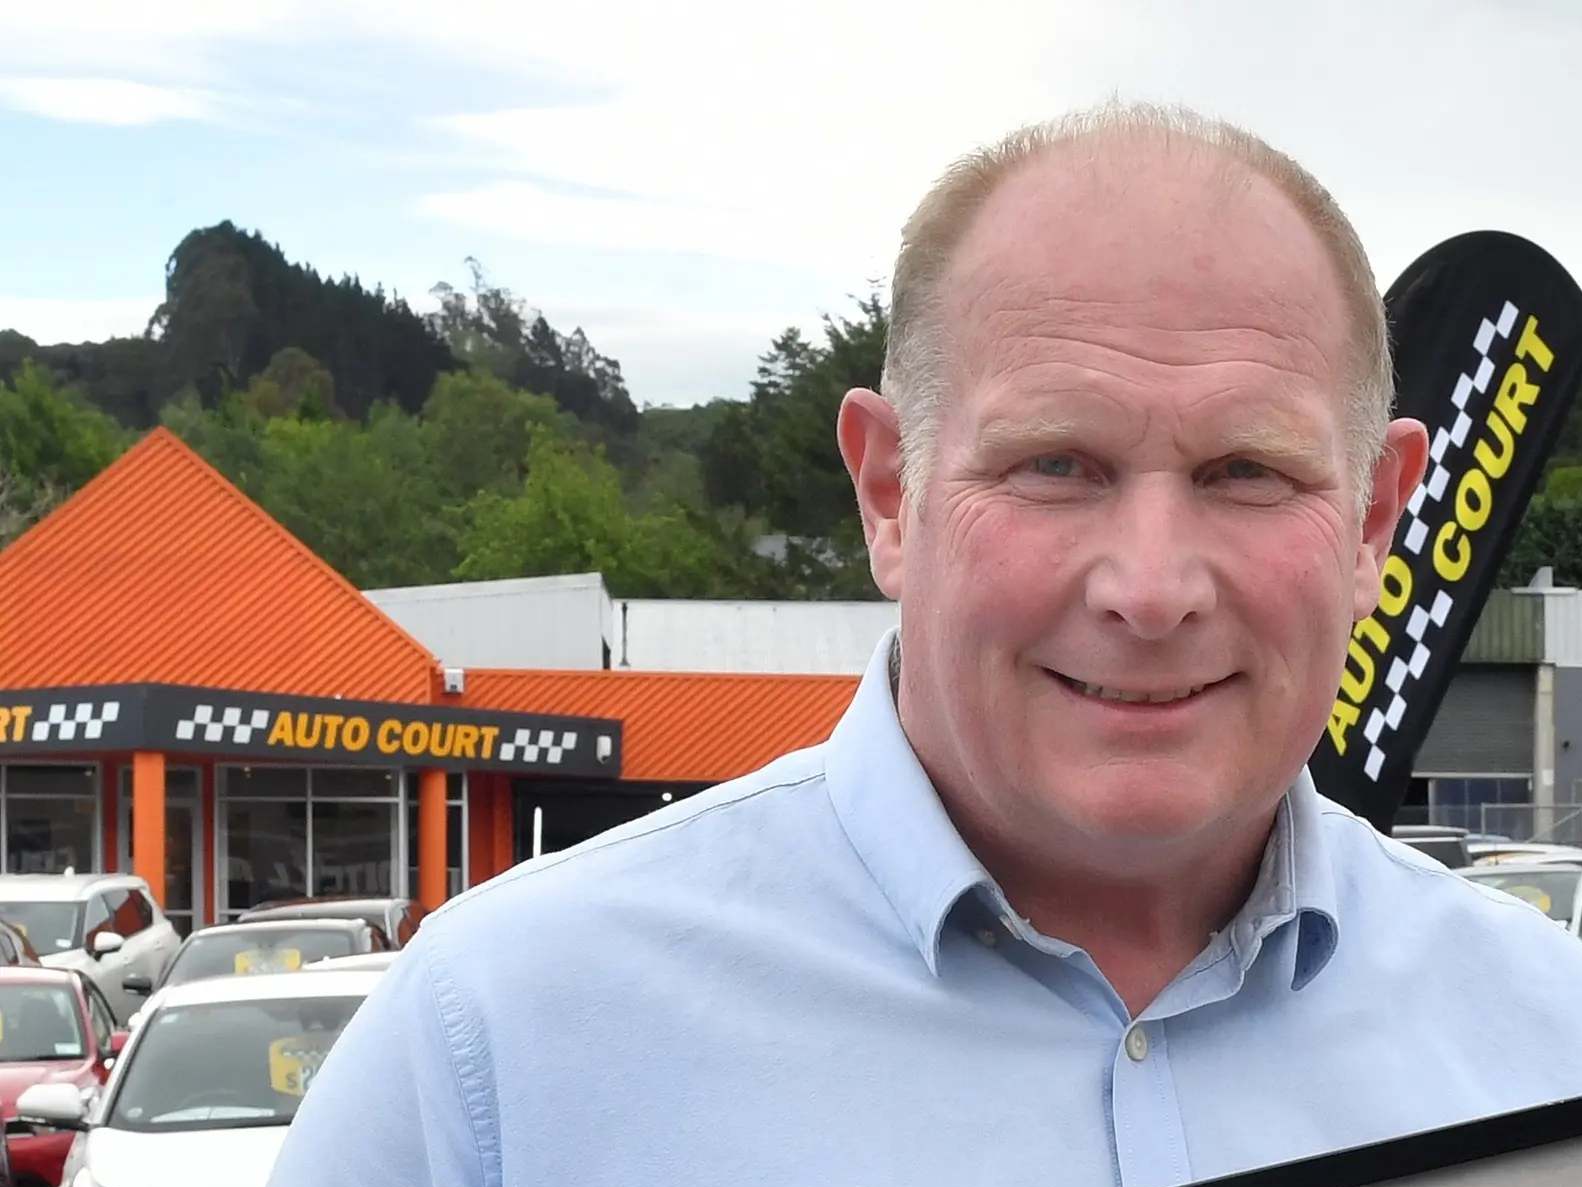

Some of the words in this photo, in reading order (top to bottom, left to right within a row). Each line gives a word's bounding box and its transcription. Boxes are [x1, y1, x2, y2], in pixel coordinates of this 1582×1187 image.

[1327, 555, 1413, 757] AUTO
[1432, 315, 1556, 582] COURT
[267, 710, 371, 752] AUTO
[376, 717, 500, 760] COURT
